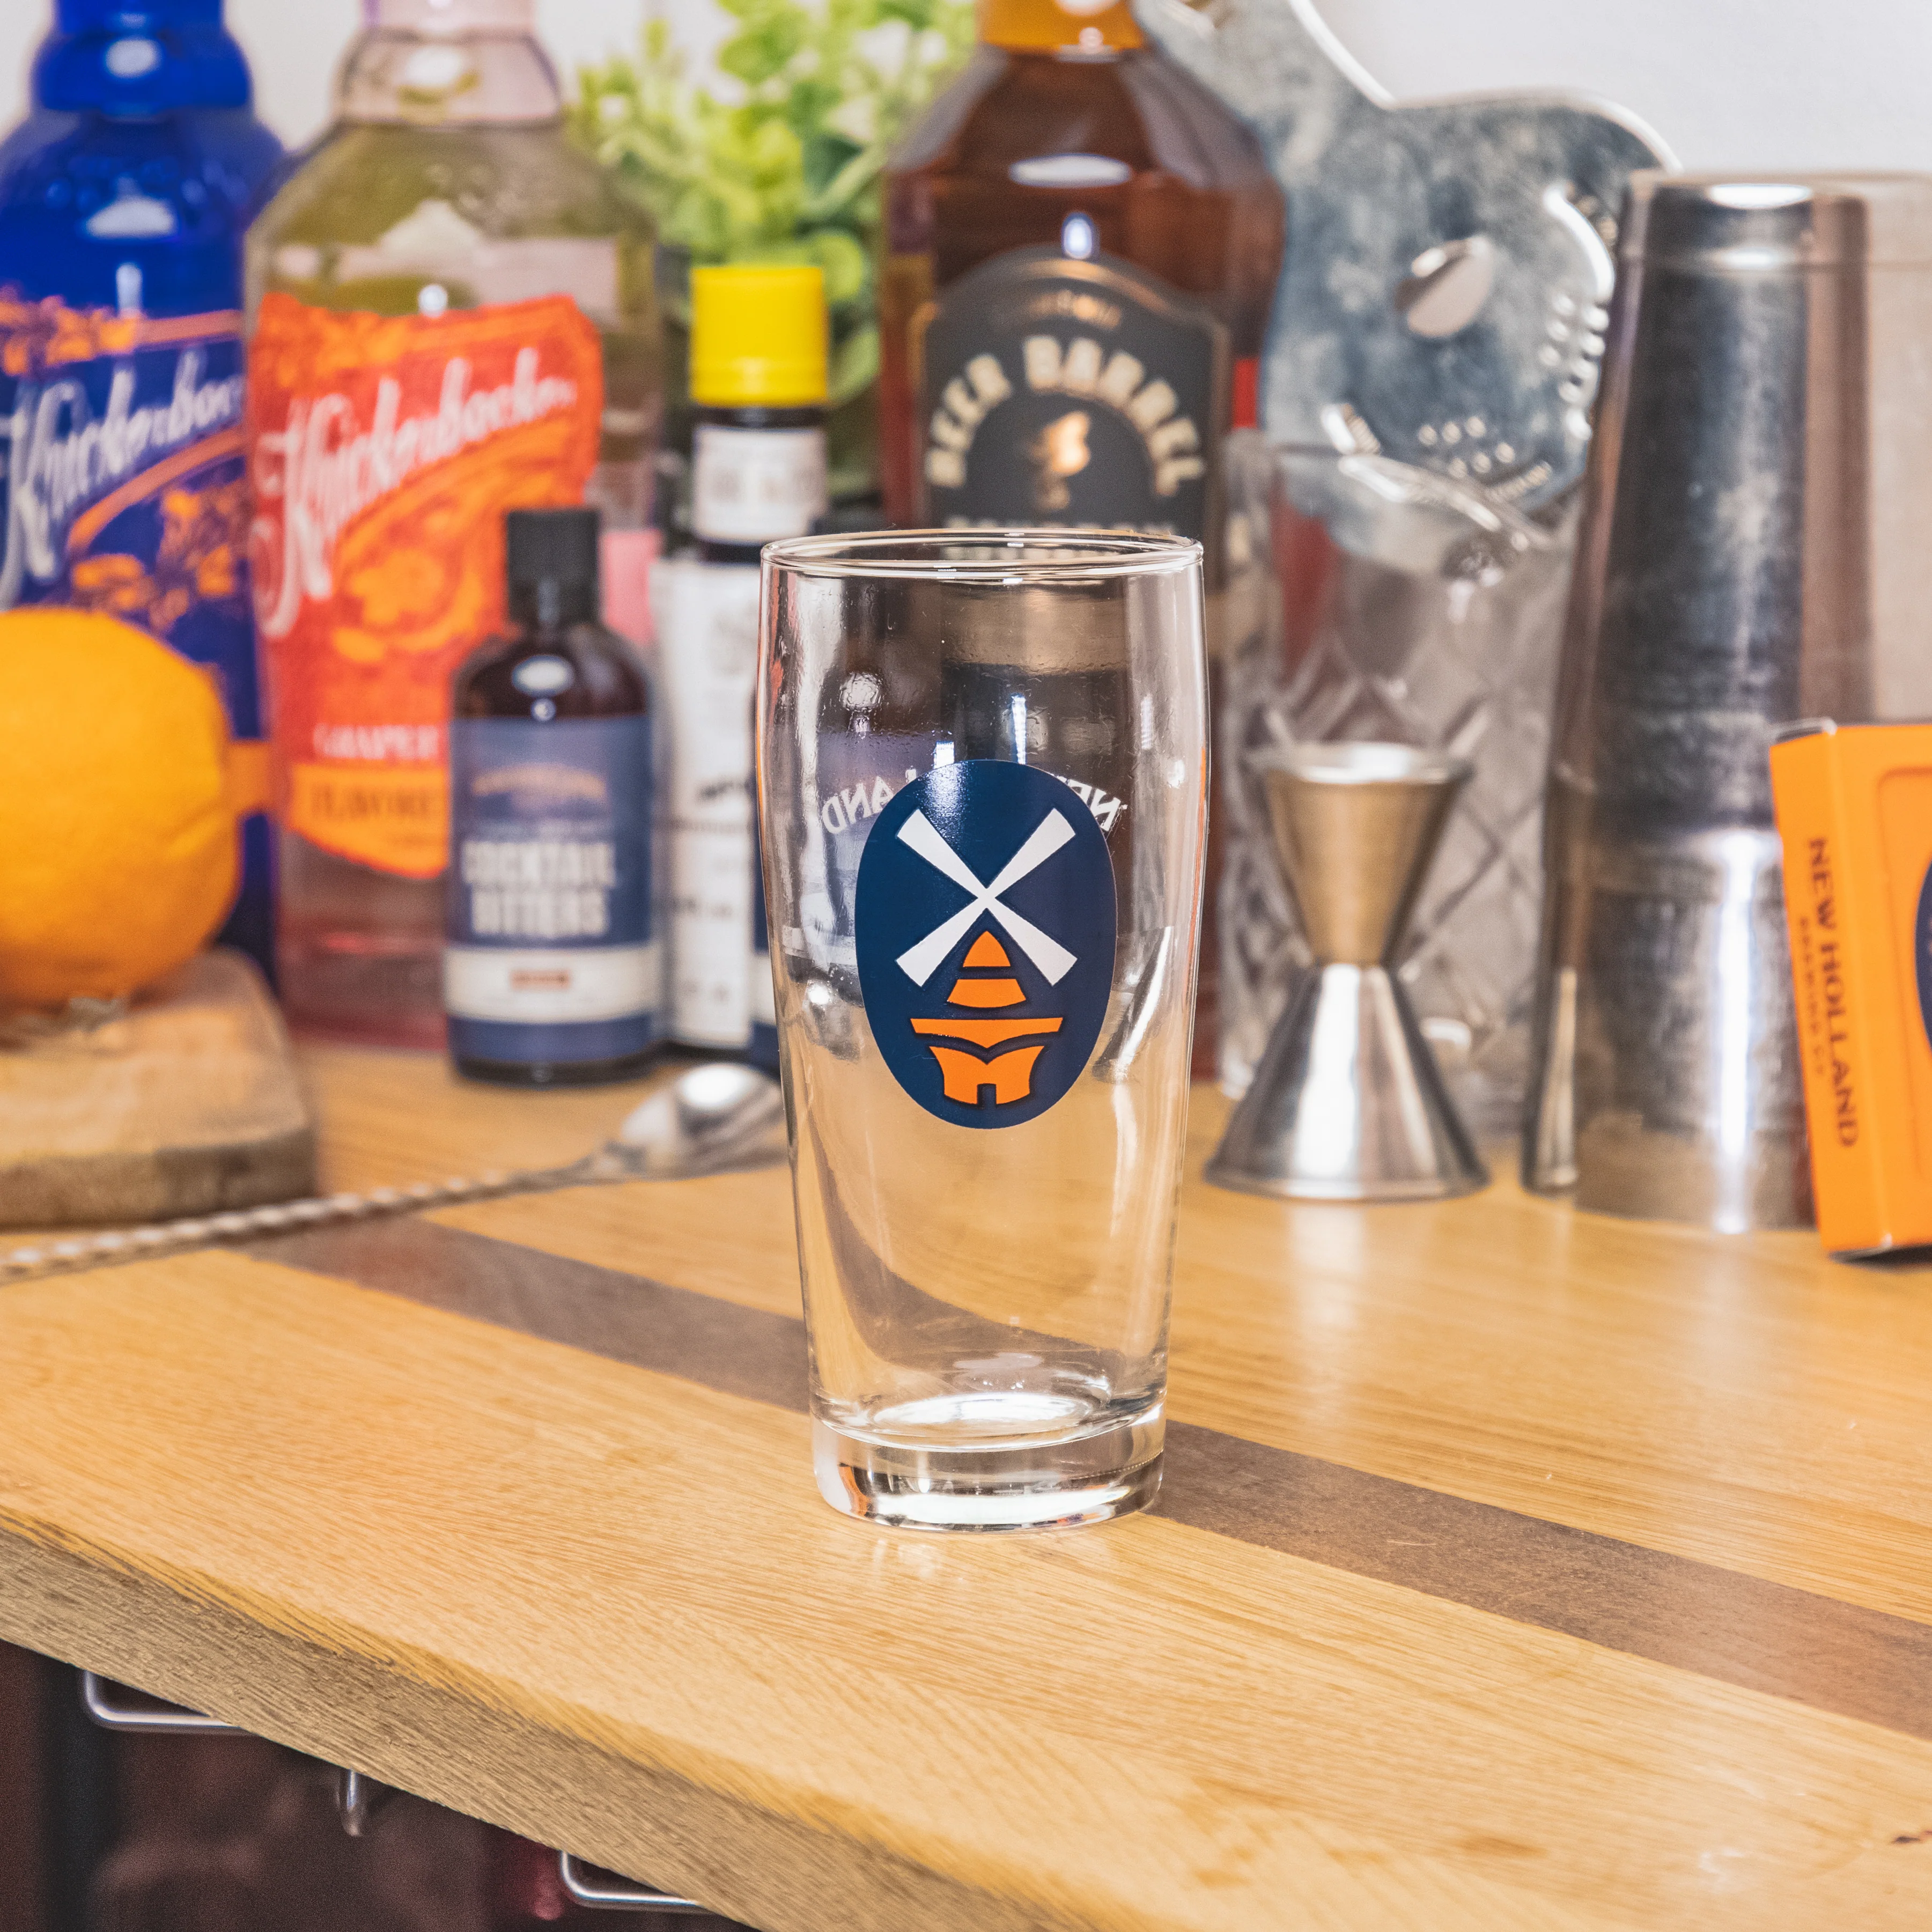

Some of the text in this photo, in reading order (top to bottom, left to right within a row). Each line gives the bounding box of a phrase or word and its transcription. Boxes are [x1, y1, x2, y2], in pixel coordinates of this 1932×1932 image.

[1023, 335, 1206, 495] BARREL
[311, 723, 441, 761] GRAPEF
[310, 780, 443, 821] FLAVORE
[462, 840, 616, 888] COCKTAIL
[471, 888, 608, 940] BITTERS
[1809, 838, 1858, 1147] NEW HOLLAND
